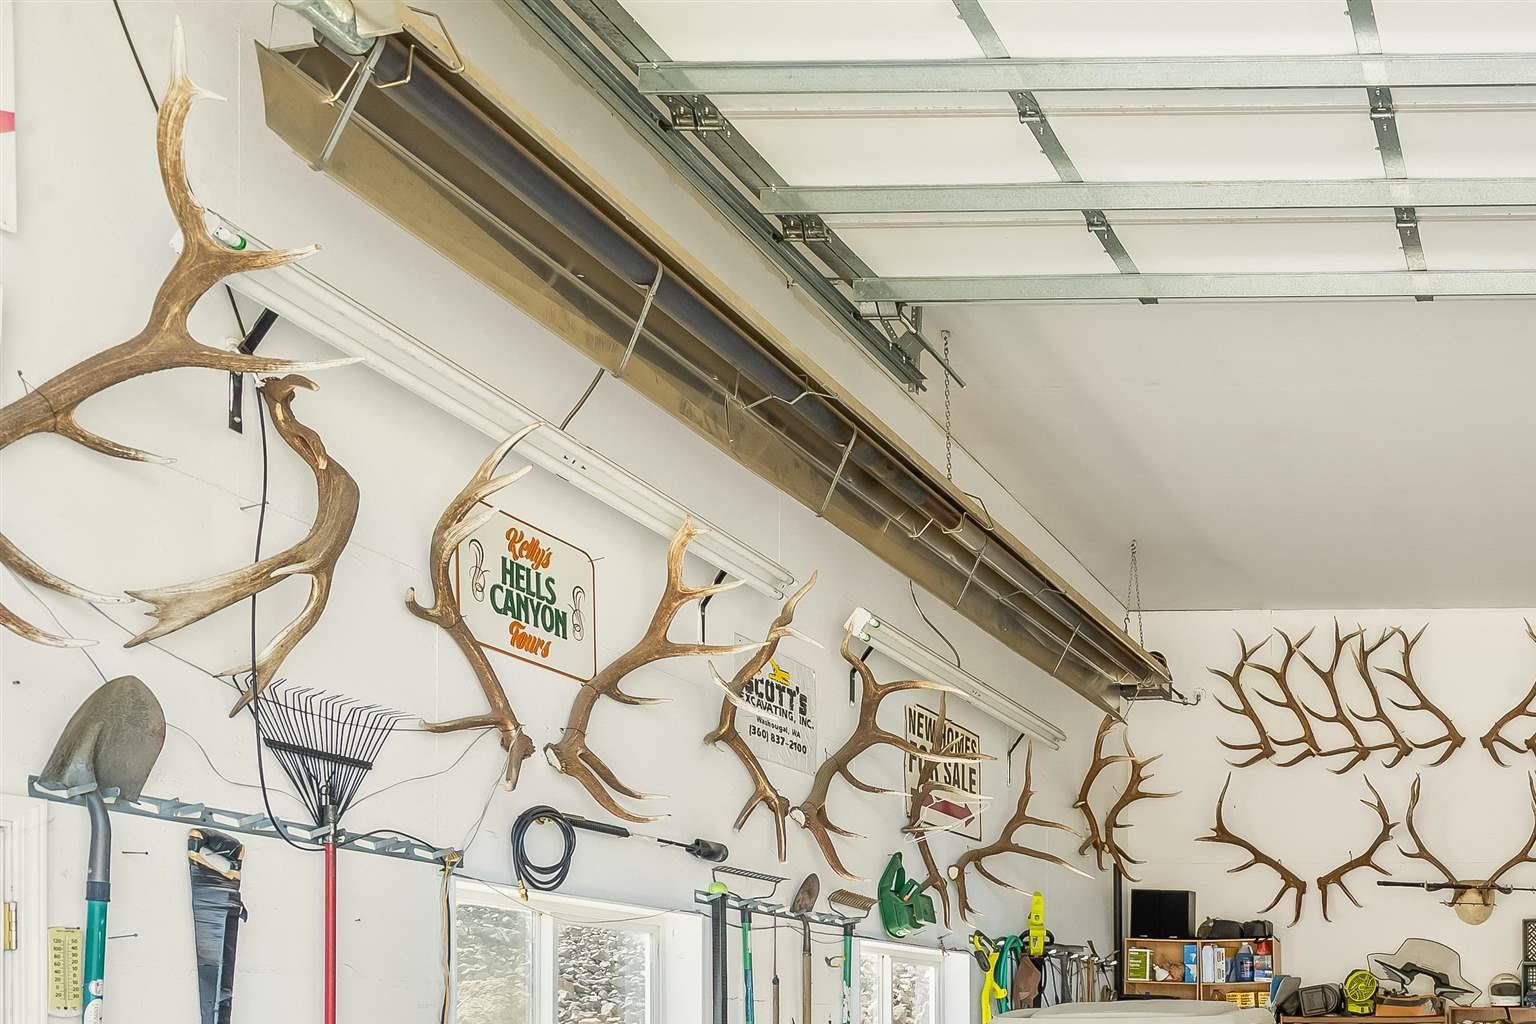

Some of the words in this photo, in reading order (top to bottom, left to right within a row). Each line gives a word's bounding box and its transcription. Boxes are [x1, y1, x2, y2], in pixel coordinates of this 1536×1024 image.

[505, 527, 553, 570] Kelly's
[501, 556, 557, 605] HELLS
[490, 583, 568, 640] CANYON
[508, 620, 552, 658] Tours
[908, 707, 935, 743] NEW
[909, 740, 939, 782] FO
[944, 761, 977, 794] SALE
